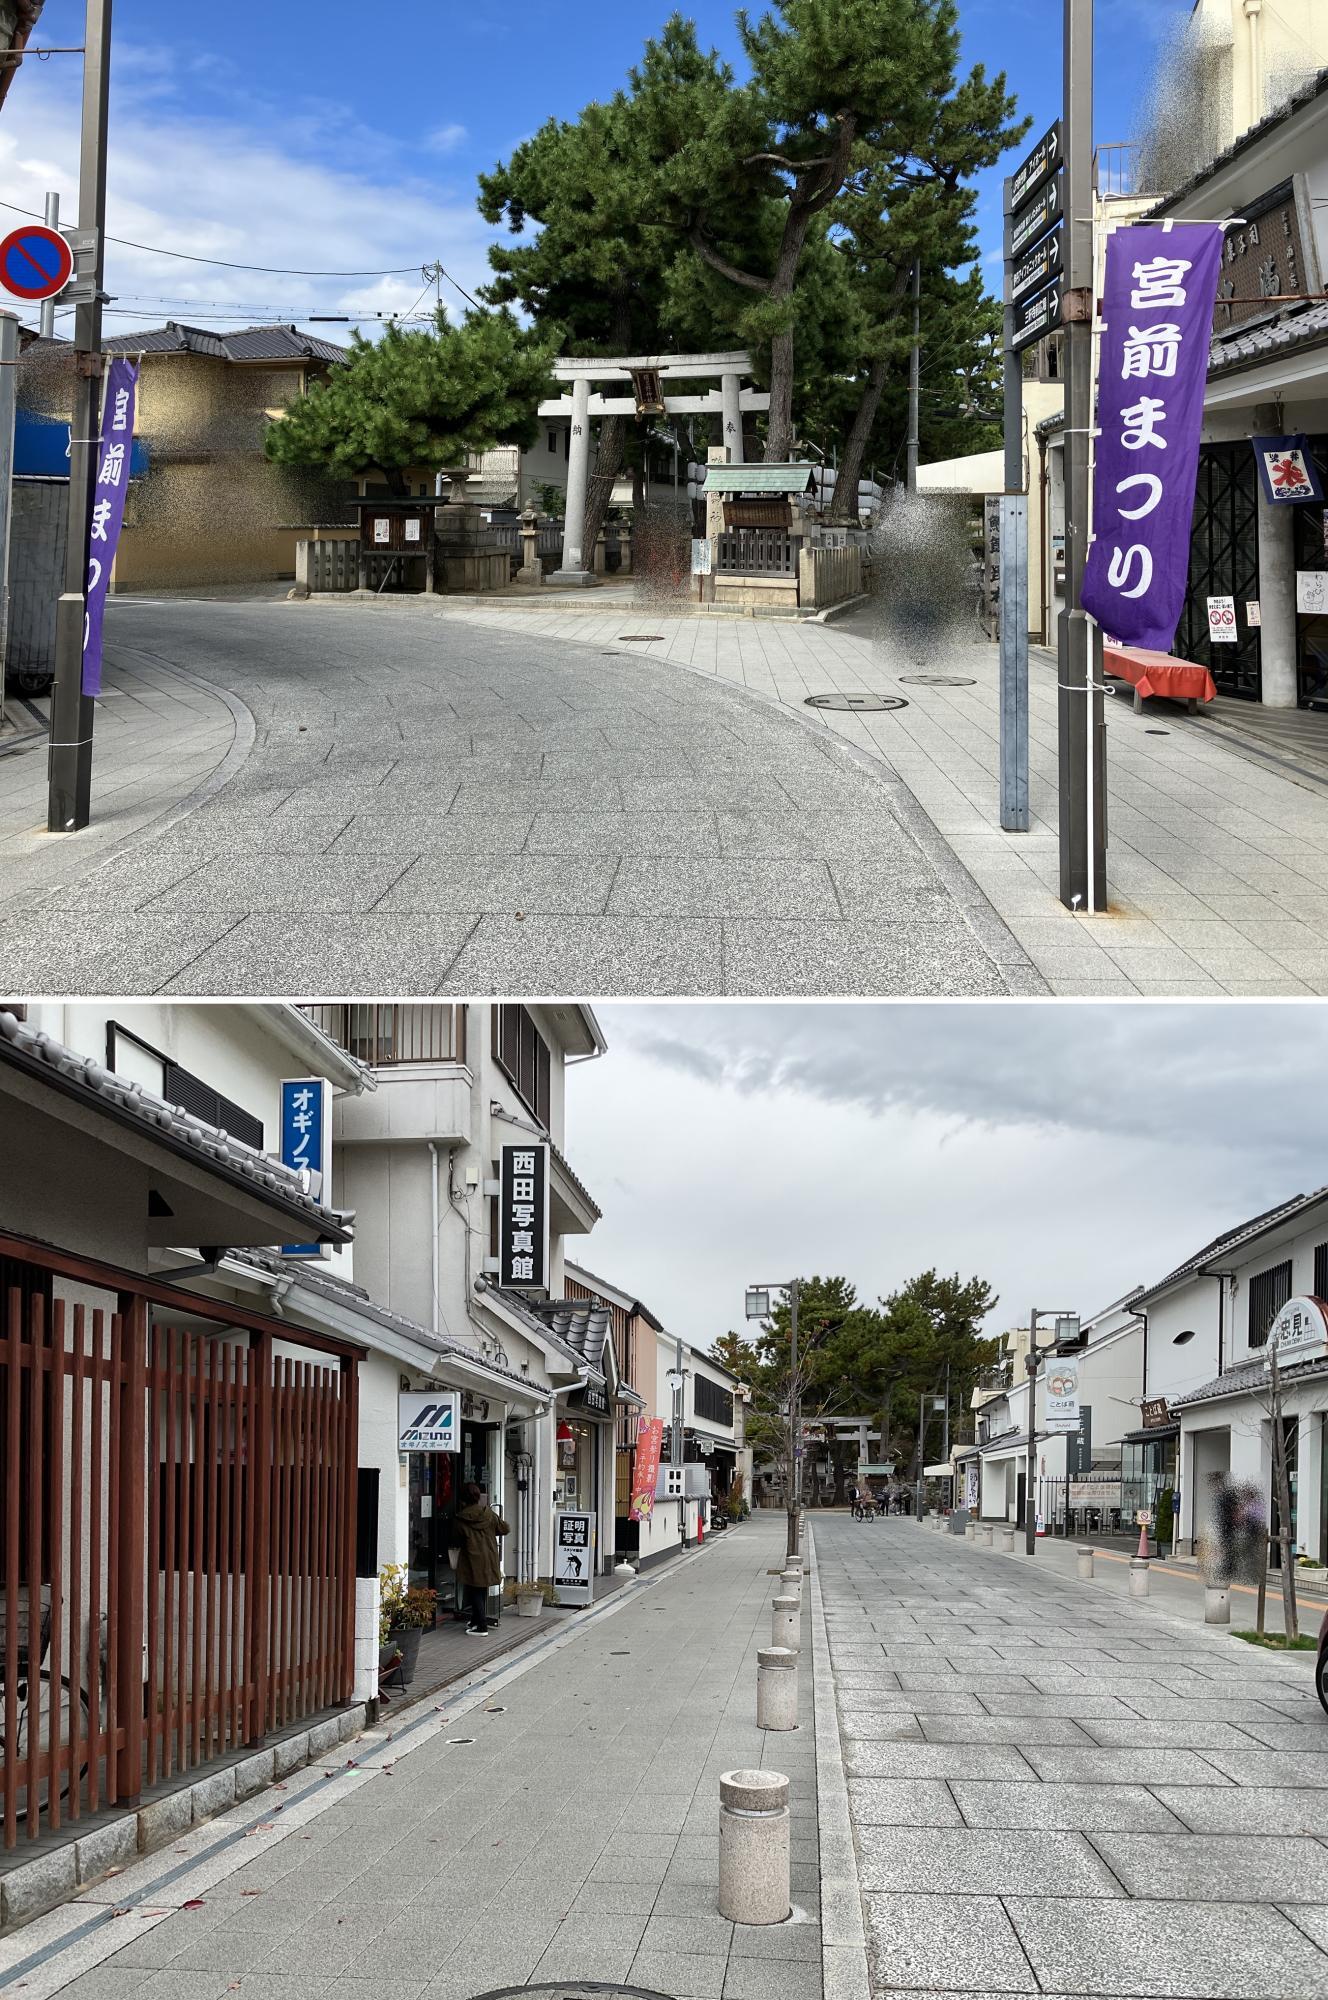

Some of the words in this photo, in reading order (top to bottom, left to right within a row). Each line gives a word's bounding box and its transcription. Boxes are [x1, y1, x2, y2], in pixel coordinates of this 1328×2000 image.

[1107, 256, 1192, 599] 宮前まつり
[1272, 458, 1307, 488] 氷
[511, 1151, 536, 1280] 西田写真館
[563, 1520, 585, 1531] 証明
[563, 1532, 585, 1544] 写真
